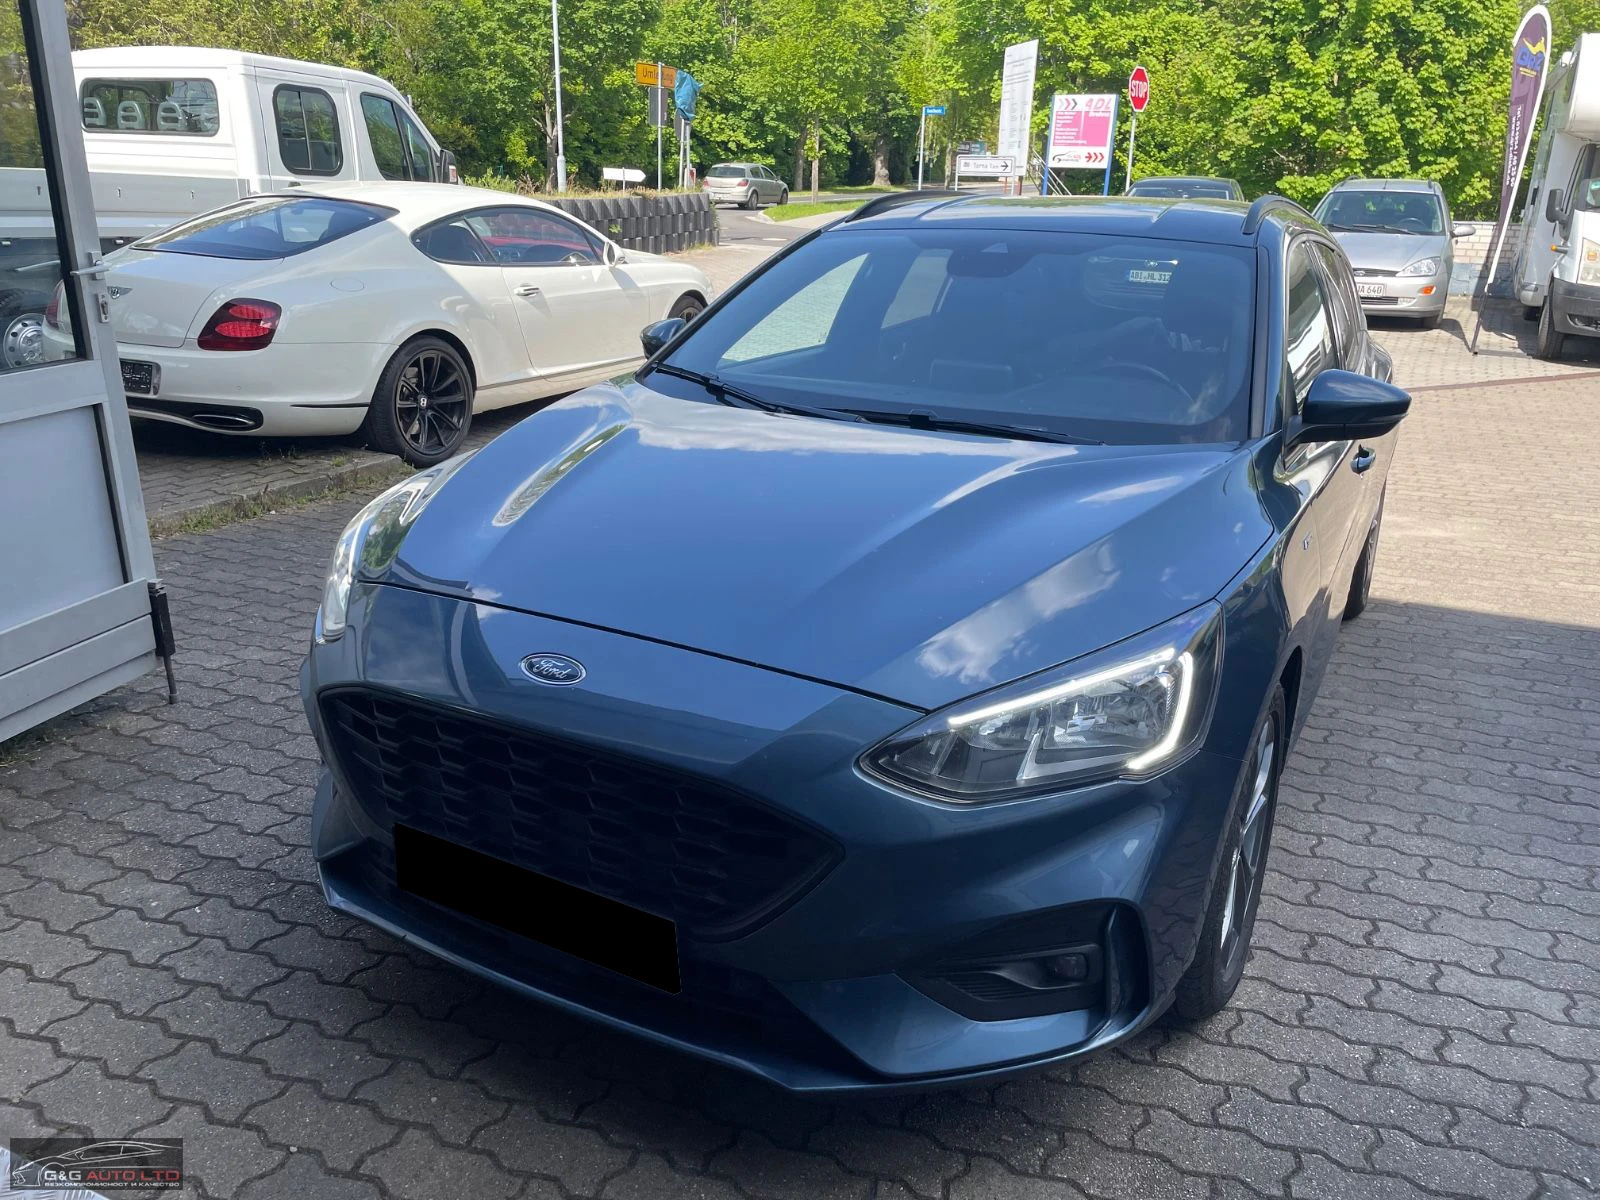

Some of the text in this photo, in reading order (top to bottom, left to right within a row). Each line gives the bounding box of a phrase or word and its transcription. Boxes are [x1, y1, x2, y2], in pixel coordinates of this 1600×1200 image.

[1131, 80, 1148, 98] STOP
[1367, 286, 1382, 294] 640
[532, 659, 572, 679] Ford
